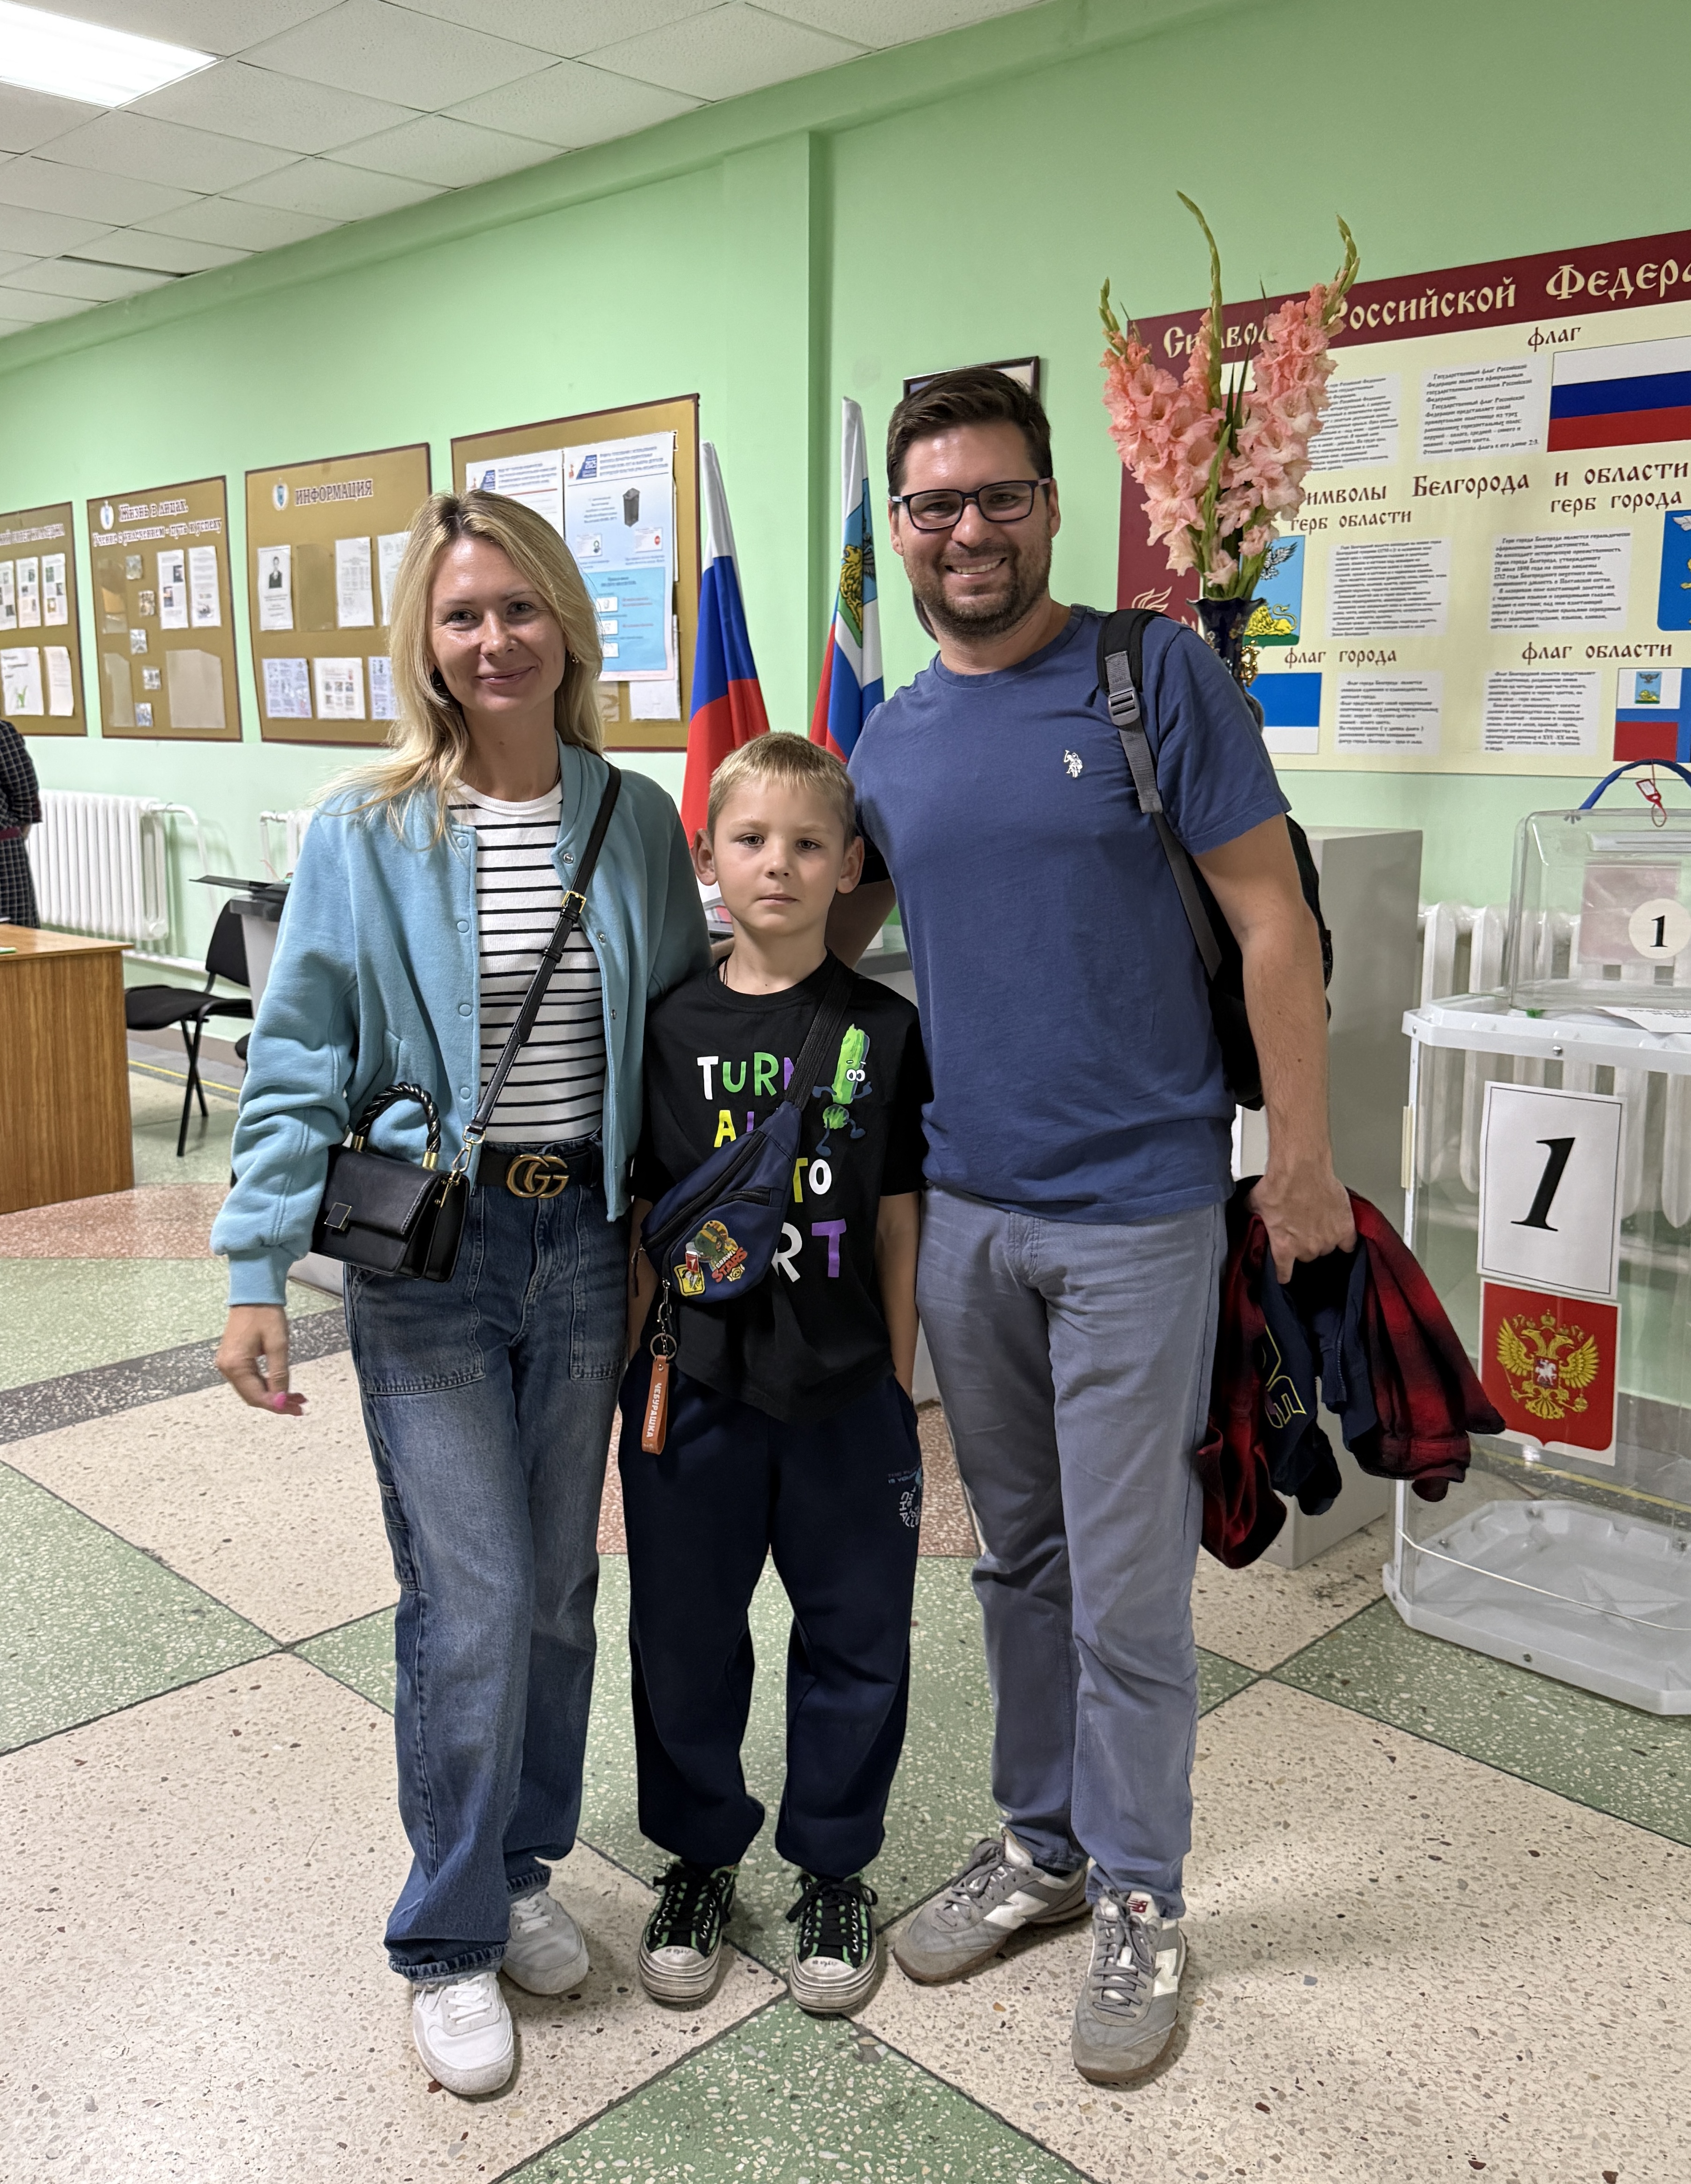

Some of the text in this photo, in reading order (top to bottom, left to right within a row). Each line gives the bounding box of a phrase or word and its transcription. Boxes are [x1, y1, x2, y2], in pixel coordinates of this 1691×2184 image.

[1164, 322, 1275, 357] Сивол
[1528, 326, 1581, 352] флаг
[295, 479, 373, 505] ИНФОРМАЦИЯ
[1305, 462, 1688, 505] имволы Белгорода и области
[1550, 491, 1682, 517] герб города
[1291, 510, 1411, 535] герб области
[1284, 647, 1397, 669] флаг города
[1521, 642, 1672, 665] флаг области
[1650, 915, 1668, 947] 1
[793, 1158, 832, 1203] TO
[1511, 1137, 1575, 1232] 1
[712, 1247, 748, 1283] STARS
[771, 1218, 846, 1283] RT
[646, 1383, 662, 1438] ЧЕБУРАШКА
